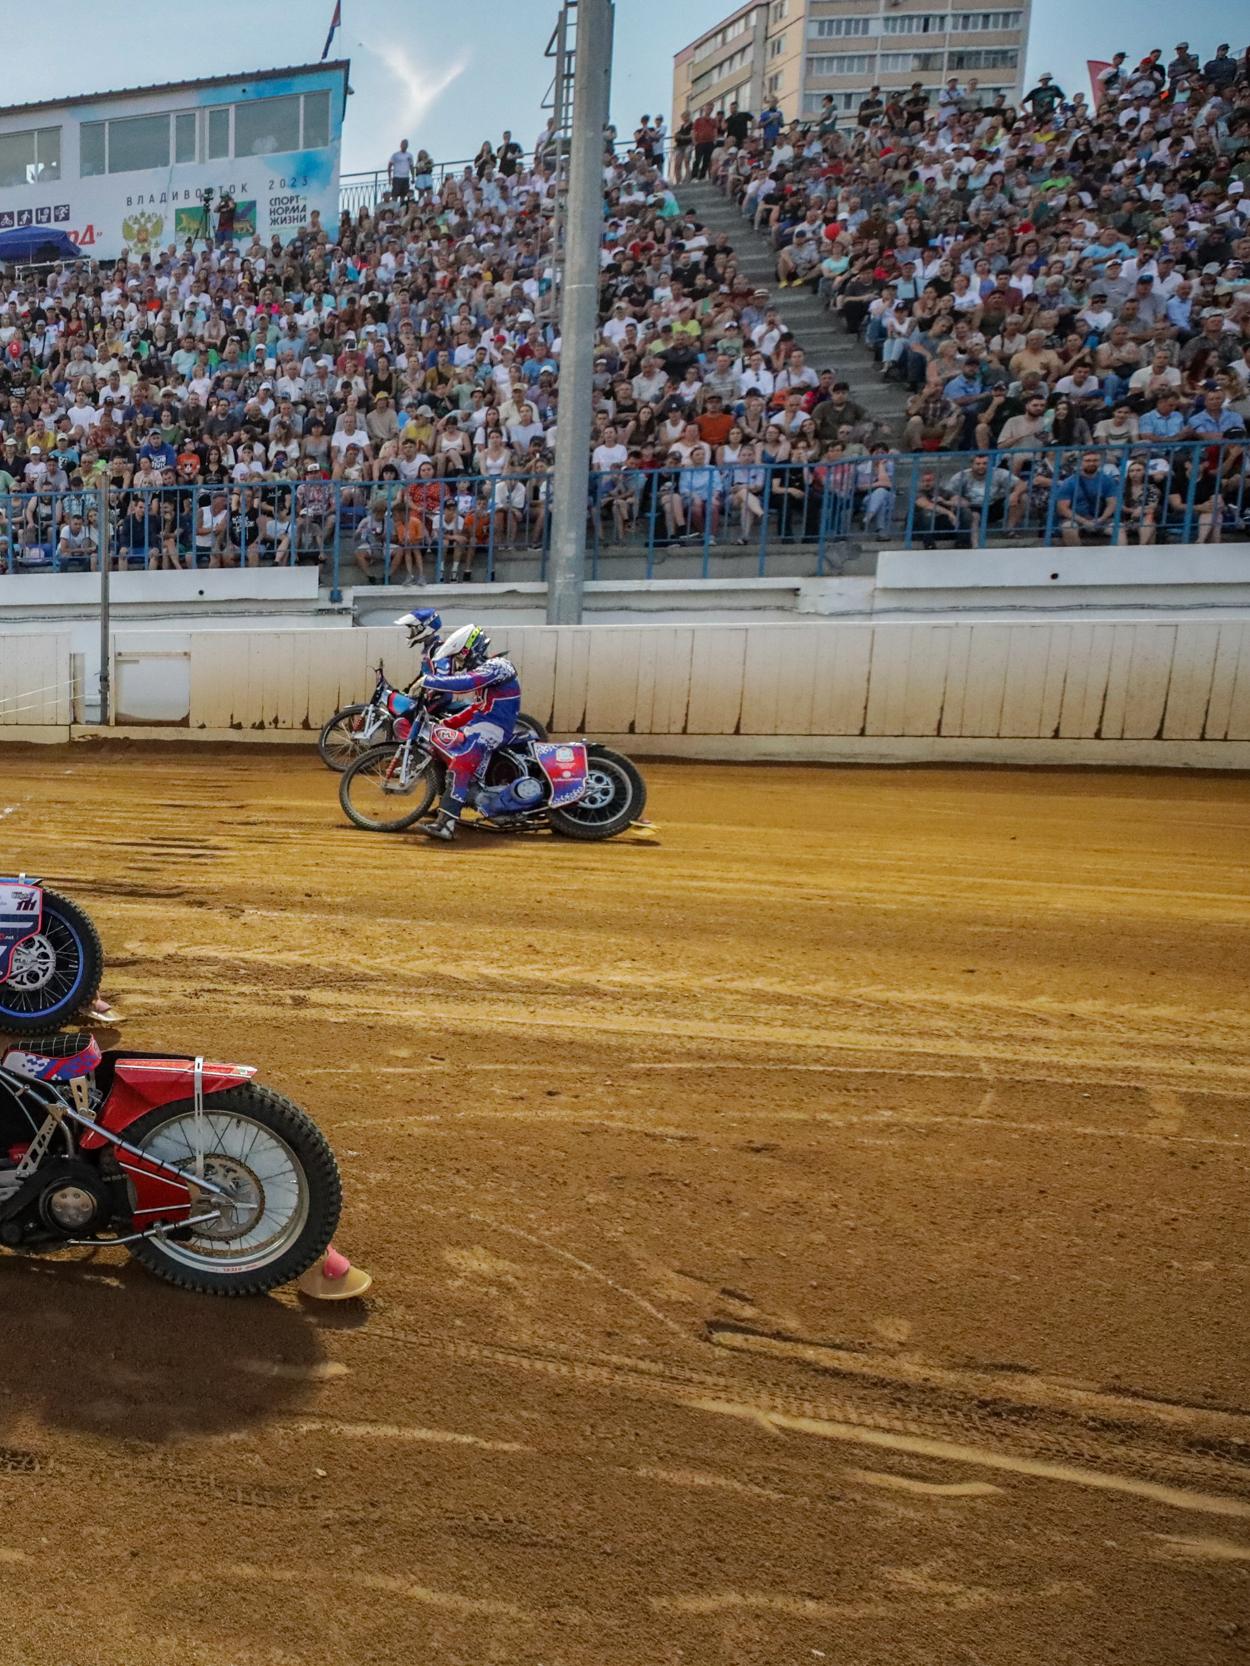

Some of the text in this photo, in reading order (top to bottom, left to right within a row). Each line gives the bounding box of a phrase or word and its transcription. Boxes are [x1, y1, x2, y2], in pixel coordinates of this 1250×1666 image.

[126, 175, 308, 206] ВЛАДИВОТОК 2023
[269, 204, 307, 216] НОРМА
[269, 214, 307, 226] ЖИЗНИ
